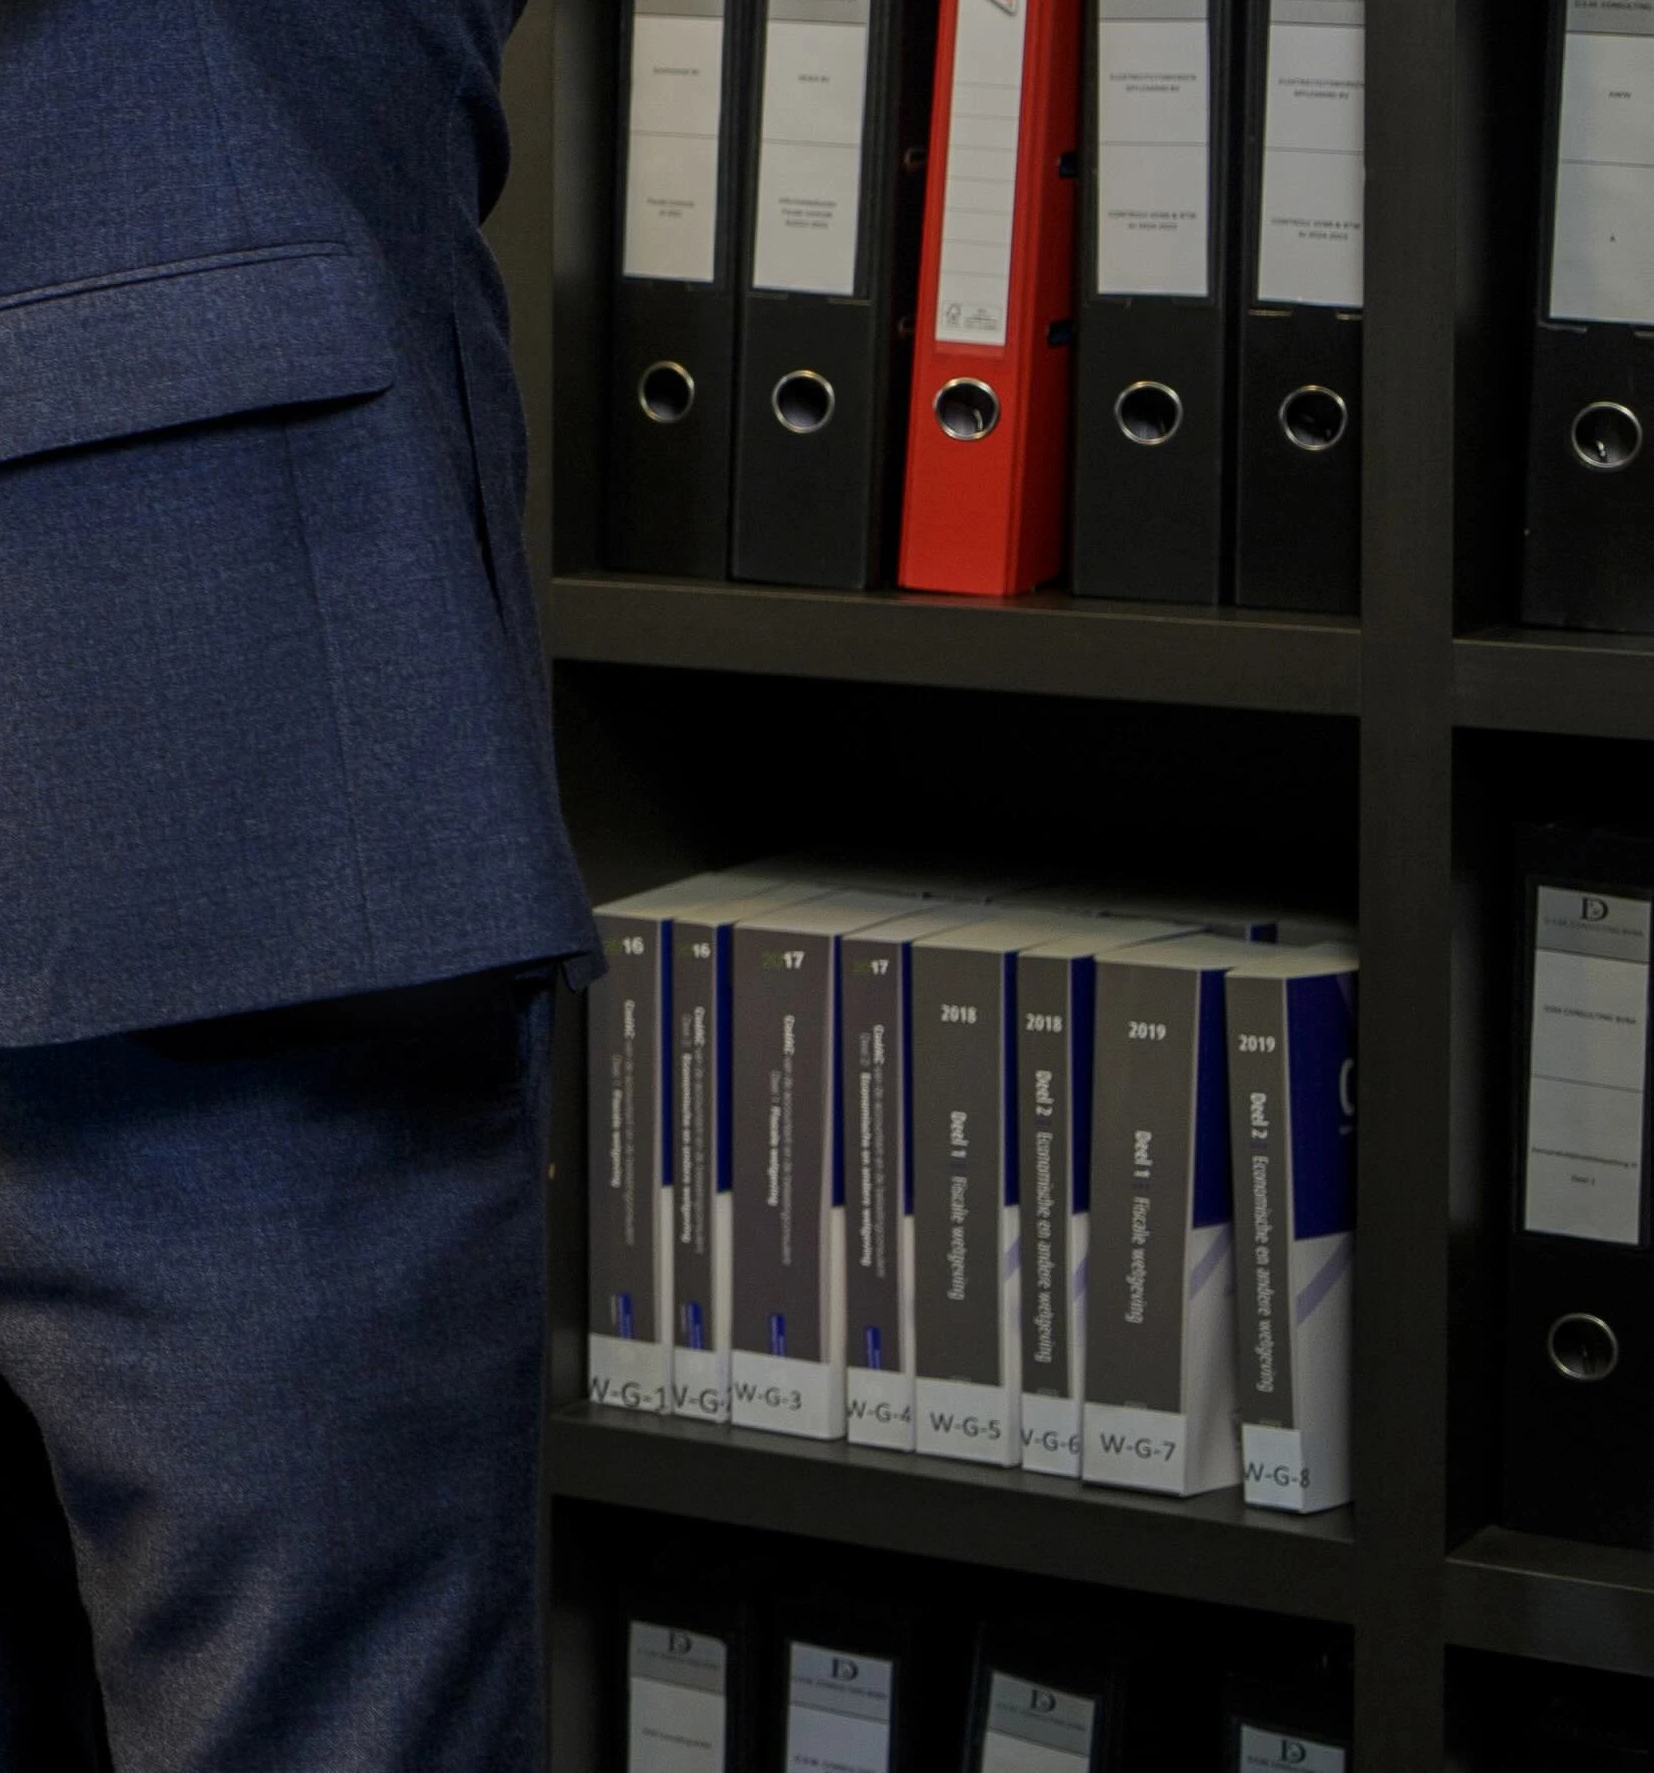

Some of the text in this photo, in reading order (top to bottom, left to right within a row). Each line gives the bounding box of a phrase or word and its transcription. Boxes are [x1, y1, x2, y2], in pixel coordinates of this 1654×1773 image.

[941, 1004, 978, 1024] 2018
[1026, 1013, 1063, 1033] 2018
[1128, 1021, 1166, 1041] 2019
[1238, 1034, 1276, 1054] 2019
[949, 1110, 968, 1146] Deel
[1134, 1129, 1153, 1166] Deel
[950, 1175, 969, 1224] Fiscale
[1032, 1069, 1054, 1364] Deel 2 Economische en andere wetgeving
[1130, 1196, 1151, 1245] Fiscale
[1249, 1091, 1276, 1393] Deel 2 Economische en andere wetgeving
[947, 1225, 967, 1301] wetgeving
[1123, 1247, 1149, 1325] wetgeving
[589, 1377, 667, 1415] W-G-1
[734, 1380, 803, 1411] W-G-3
[848, 1401, 911, 1424] W-G-4
[930, 1411, 1002, 1442] W-G-5
[1099, 1432, 1176, 1463] W-G-7
[1242, 1460, 1311, 1489] W-G-8
